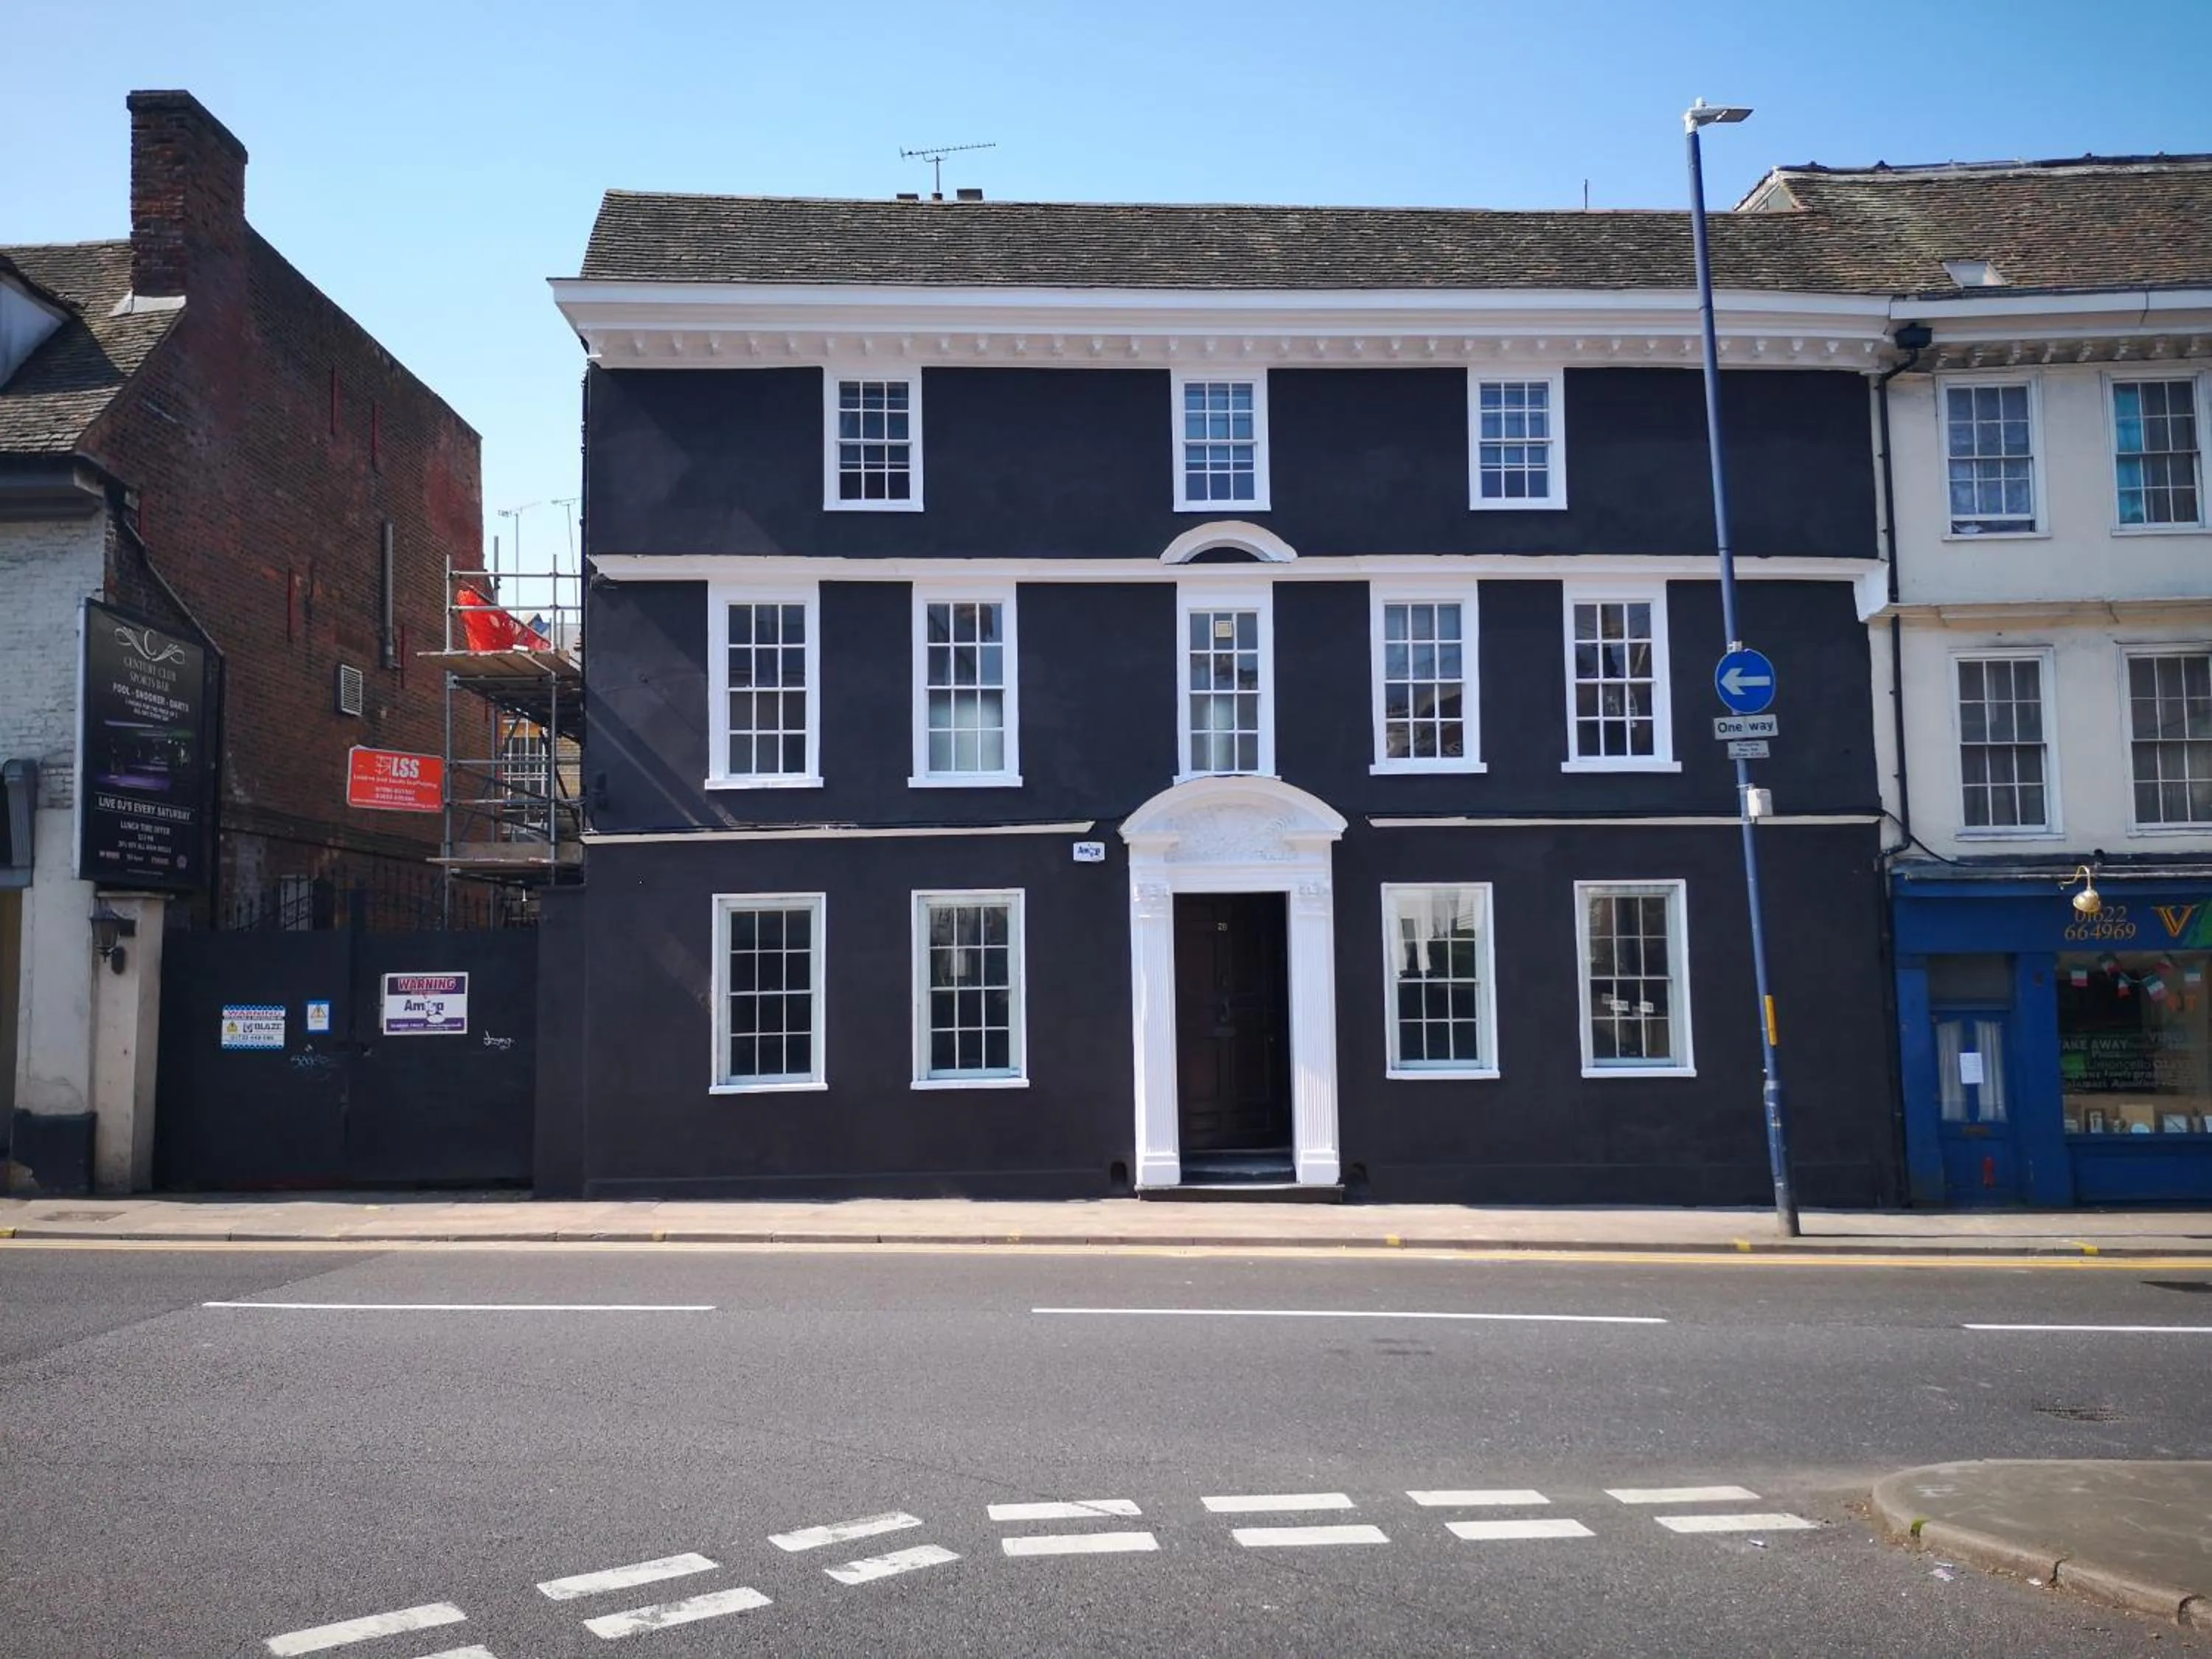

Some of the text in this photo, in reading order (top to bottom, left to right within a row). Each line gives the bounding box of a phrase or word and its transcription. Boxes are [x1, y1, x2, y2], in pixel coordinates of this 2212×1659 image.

[113, 682, 131, 695] POOL
[1718, 720, 1773, 733] One way
[391, 756, 420, 779] LSS
[98, 796, 190, 821] LIVE DJ'S EVERY SATURDAY
[2065, 922, 2137, 940] 664969
[398, 978, 457, 991] WARNING
[2091, 1039, 2129, 1051] AWAY
